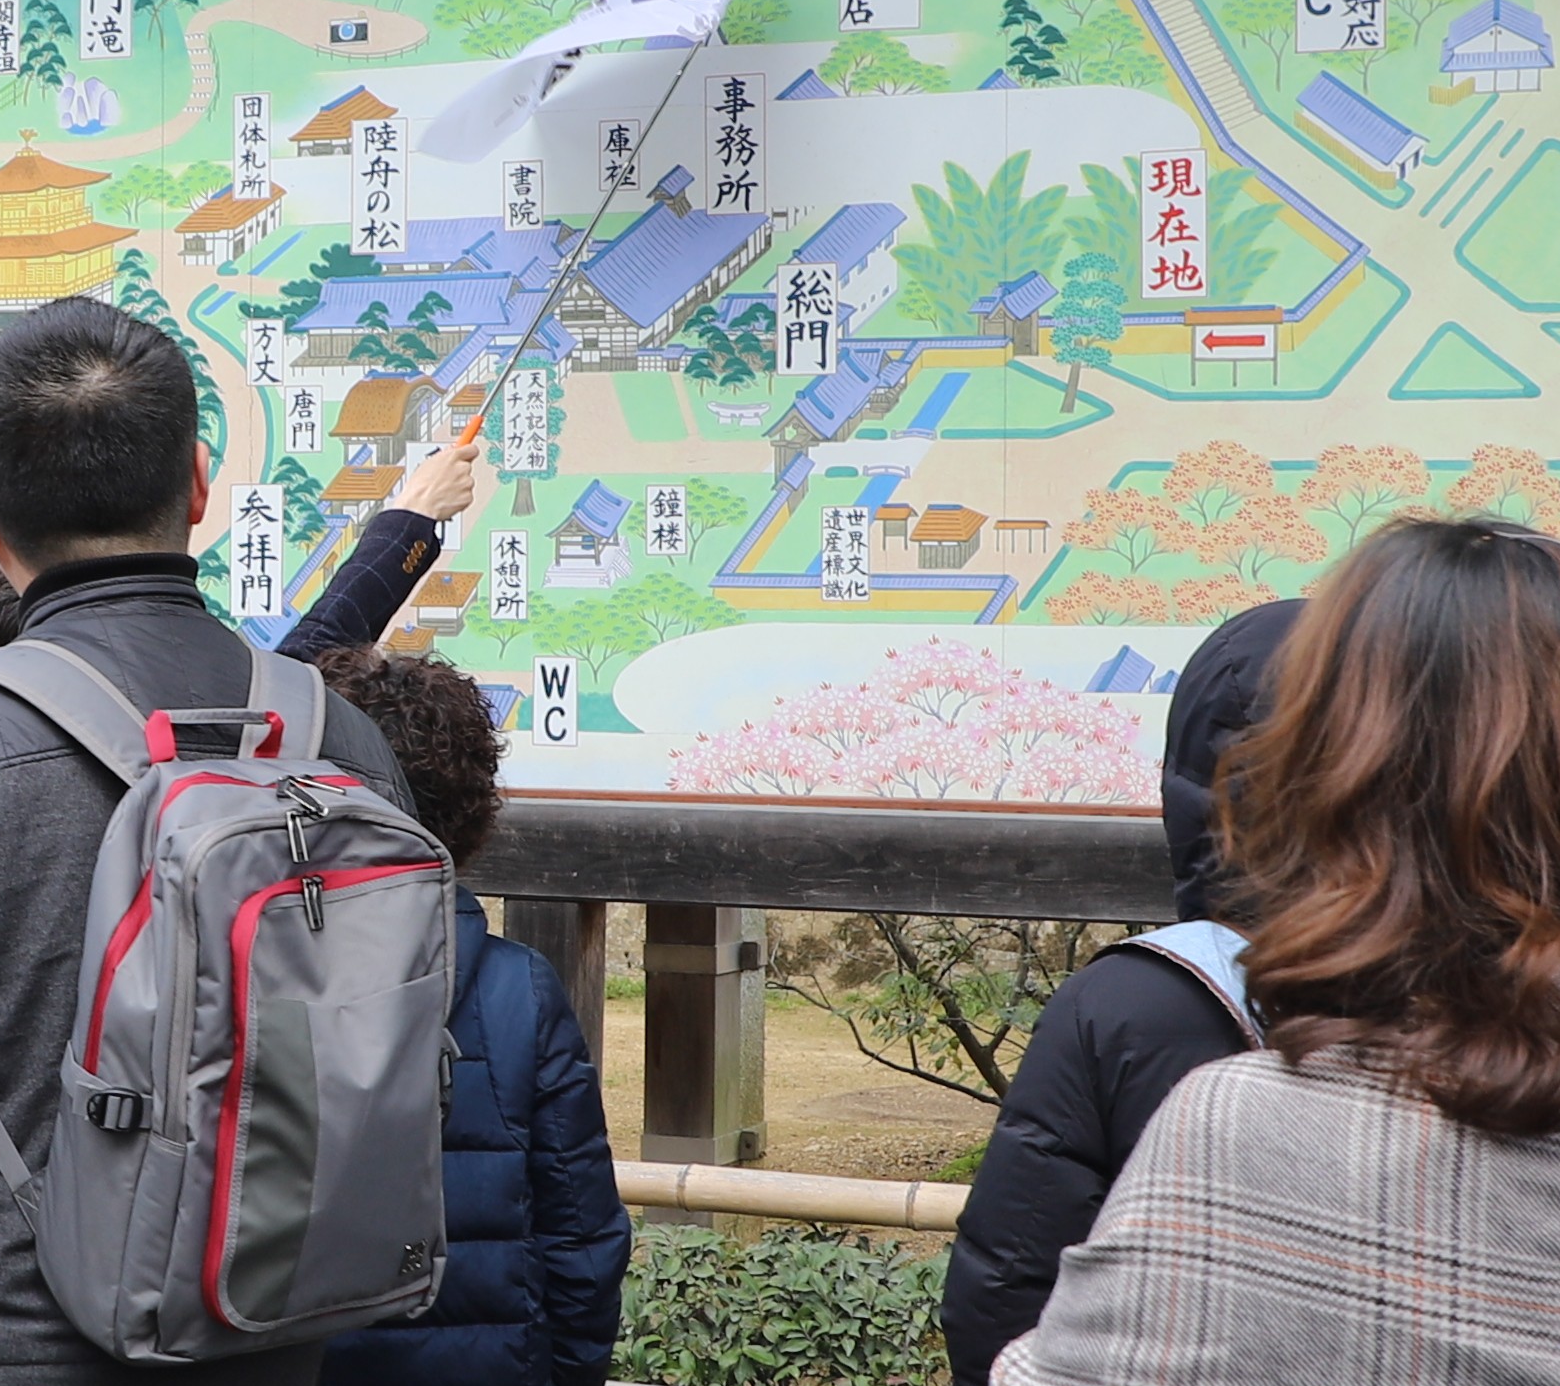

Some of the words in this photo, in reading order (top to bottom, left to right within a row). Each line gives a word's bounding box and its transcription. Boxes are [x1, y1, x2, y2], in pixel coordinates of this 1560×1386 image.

[240, 96, 267, 196] 団体札所
[360, 122, 400, 250] 陸舟の松
[713, 76, 759, 212] 事務所
[508, 162, 543, 227] 書院
[1148, 157, 1204, 291] 現在地
[253, 323, 279, 383] 方丈
[784, 269, 833, 370] 総門
[289, 388, 316, 450] 唐門
[507, 374, 525, 469] イチイガシ
[526, 373, 545, 469] 天然記念物
[238, 489, 279, 613] 参拝門
[650, 489, 683, 551] 鐘楼
[824, 509, 844, 598] 遺産標識
[846, 509, 867, 598] 世界文化
[494, 535, 526, 618] 休憩所
[540, 664, 570, 742] WC
